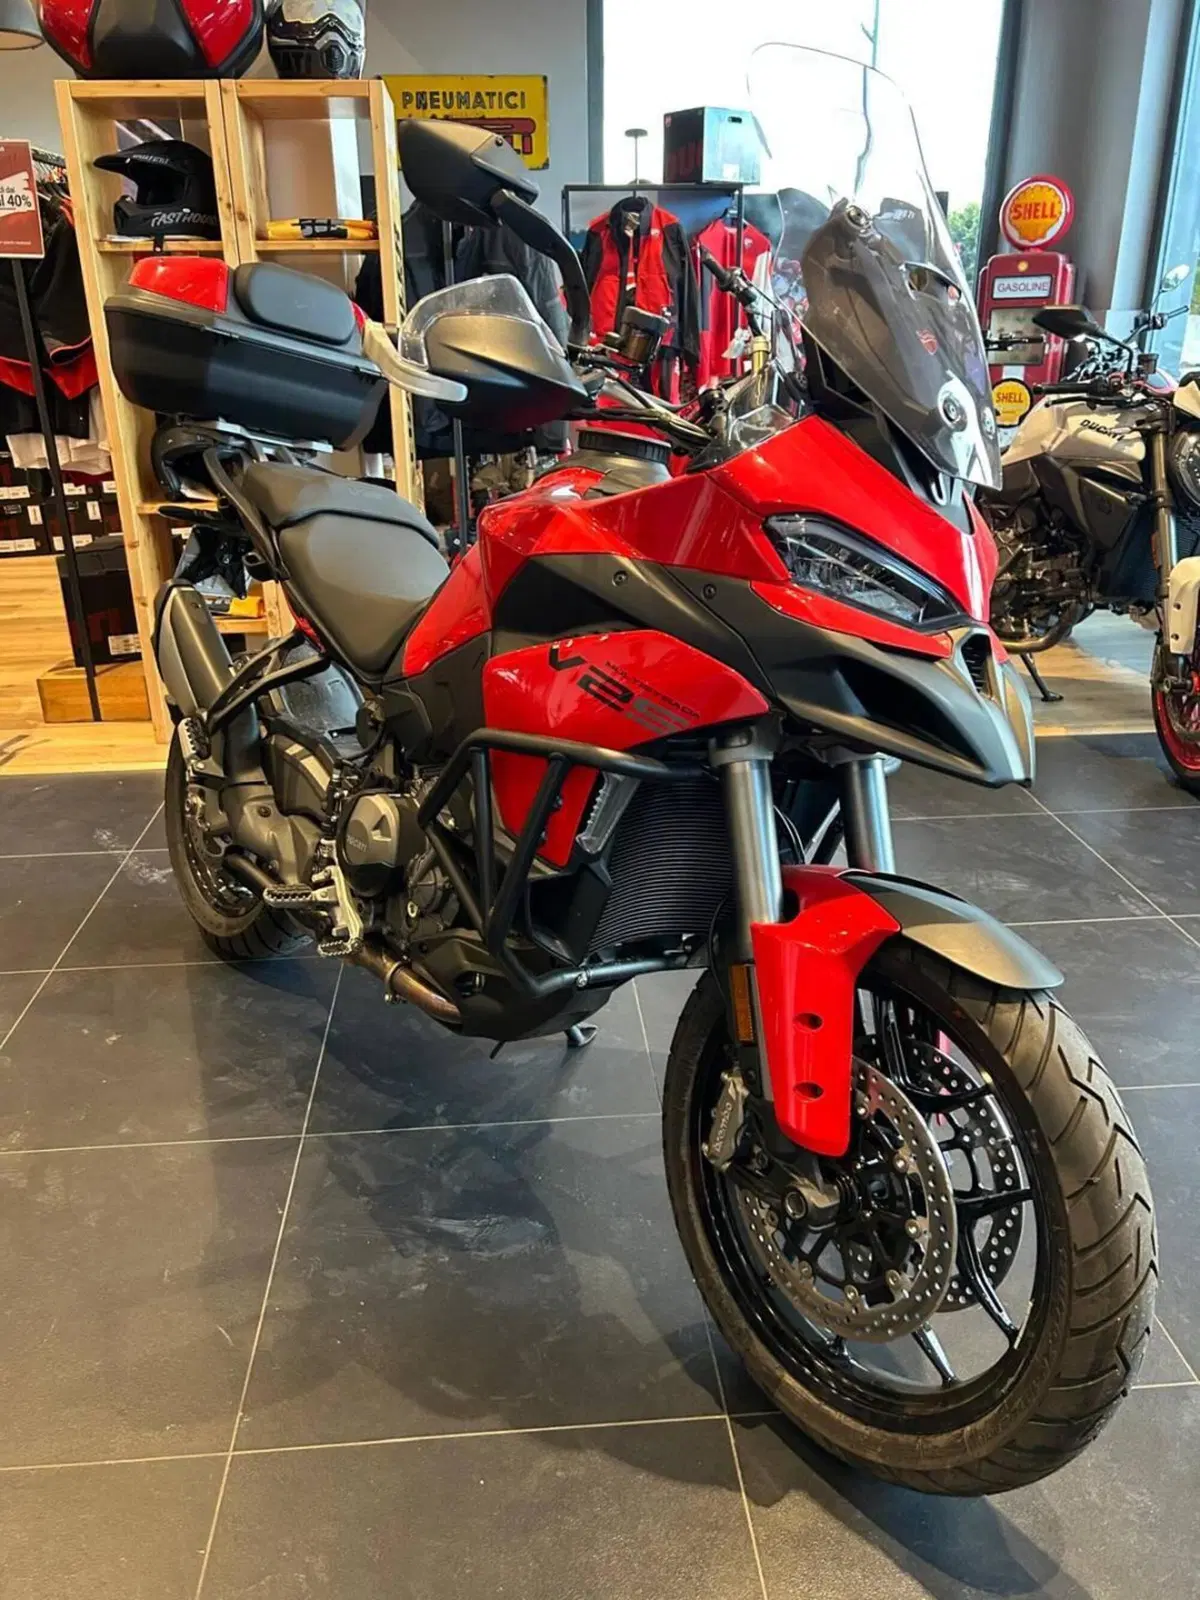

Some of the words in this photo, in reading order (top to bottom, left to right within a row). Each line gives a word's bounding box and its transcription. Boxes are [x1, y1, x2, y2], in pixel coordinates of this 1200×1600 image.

[402, 90, 526, 110] PNEUMATICI
[7, 194, 32, 208] 40%
[1012, 202, 1057, 220] SHELL
[997, 282, 1049, 293] GASOLINE
[996, 392, 1024, 404] SHELL
[1080, 419, 1125, 441] DUCATI
